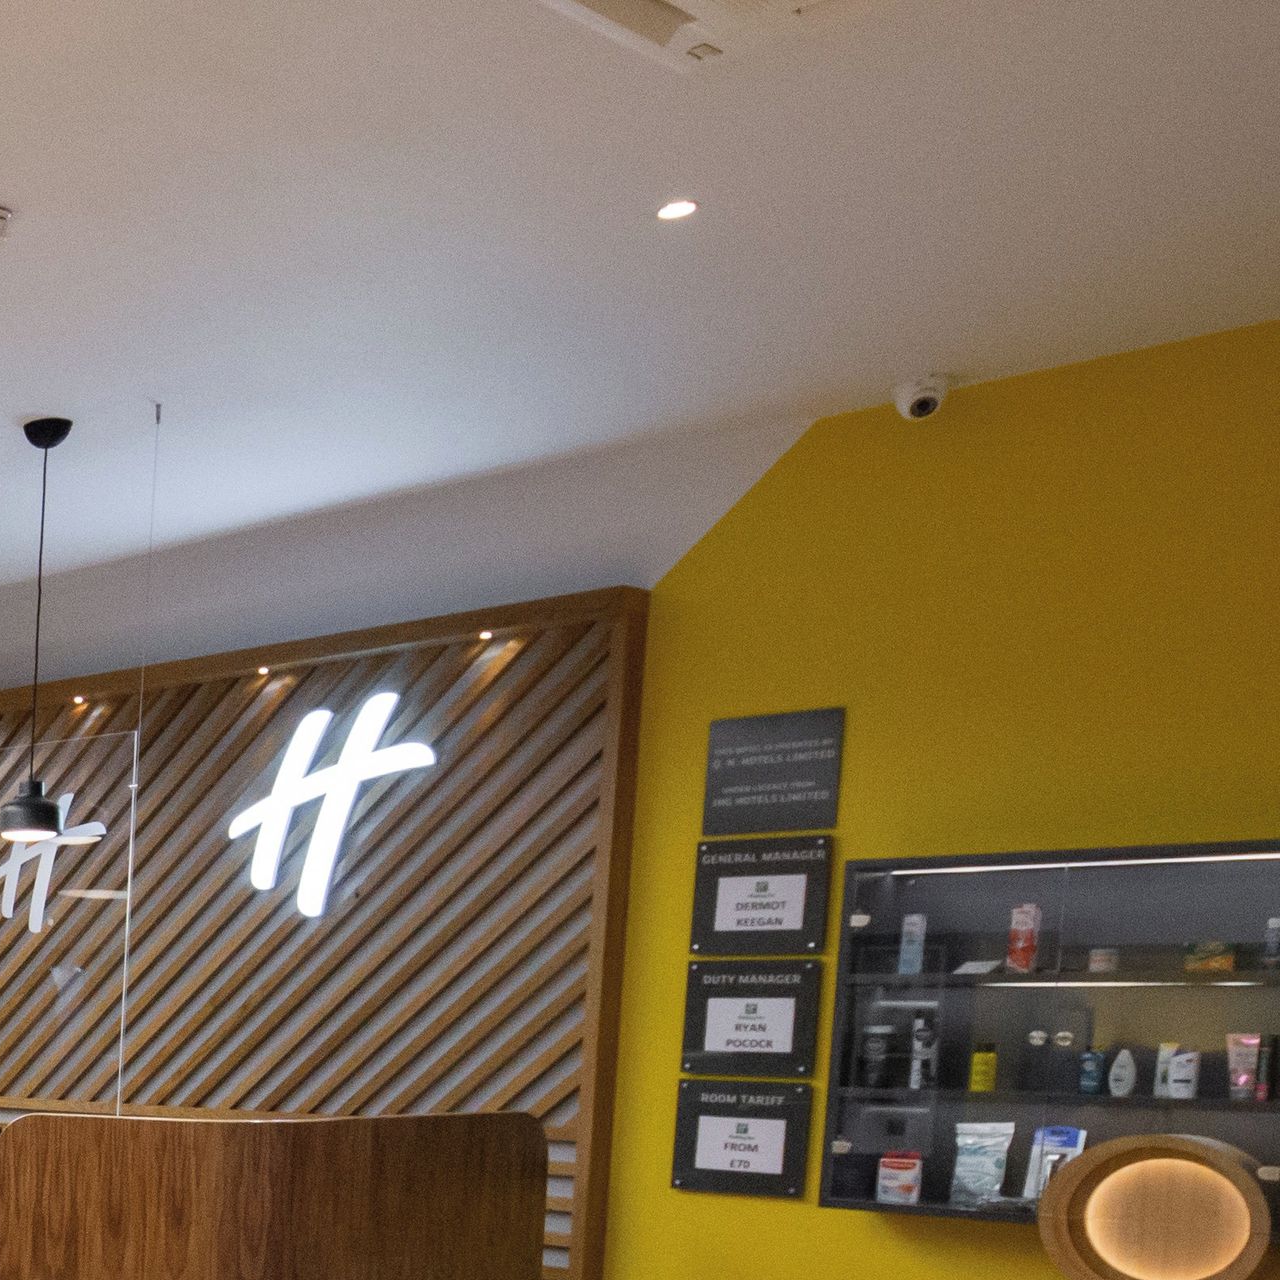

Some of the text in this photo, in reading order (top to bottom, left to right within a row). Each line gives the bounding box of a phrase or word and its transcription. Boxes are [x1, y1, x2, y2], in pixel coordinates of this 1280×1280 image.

[741, 753, 784, 767] HOTELS
[785, 749, 836, 763] LIMITED
[702, 848, 827, 865] GENERAL MANAGER
[735, 901, 787, 912] DERMOT
[736, 917, 784, 928] KEEGAN
[702, 974, 802, 985] DUTY MANAGER
[734, 1023, 767, 1033] RYAN
[725, 1038, 774, 1049] POCOCK
[700, 1092, 786, 1107] ROOM TARIFF
[723, 1142, 759, 1153] FROM
